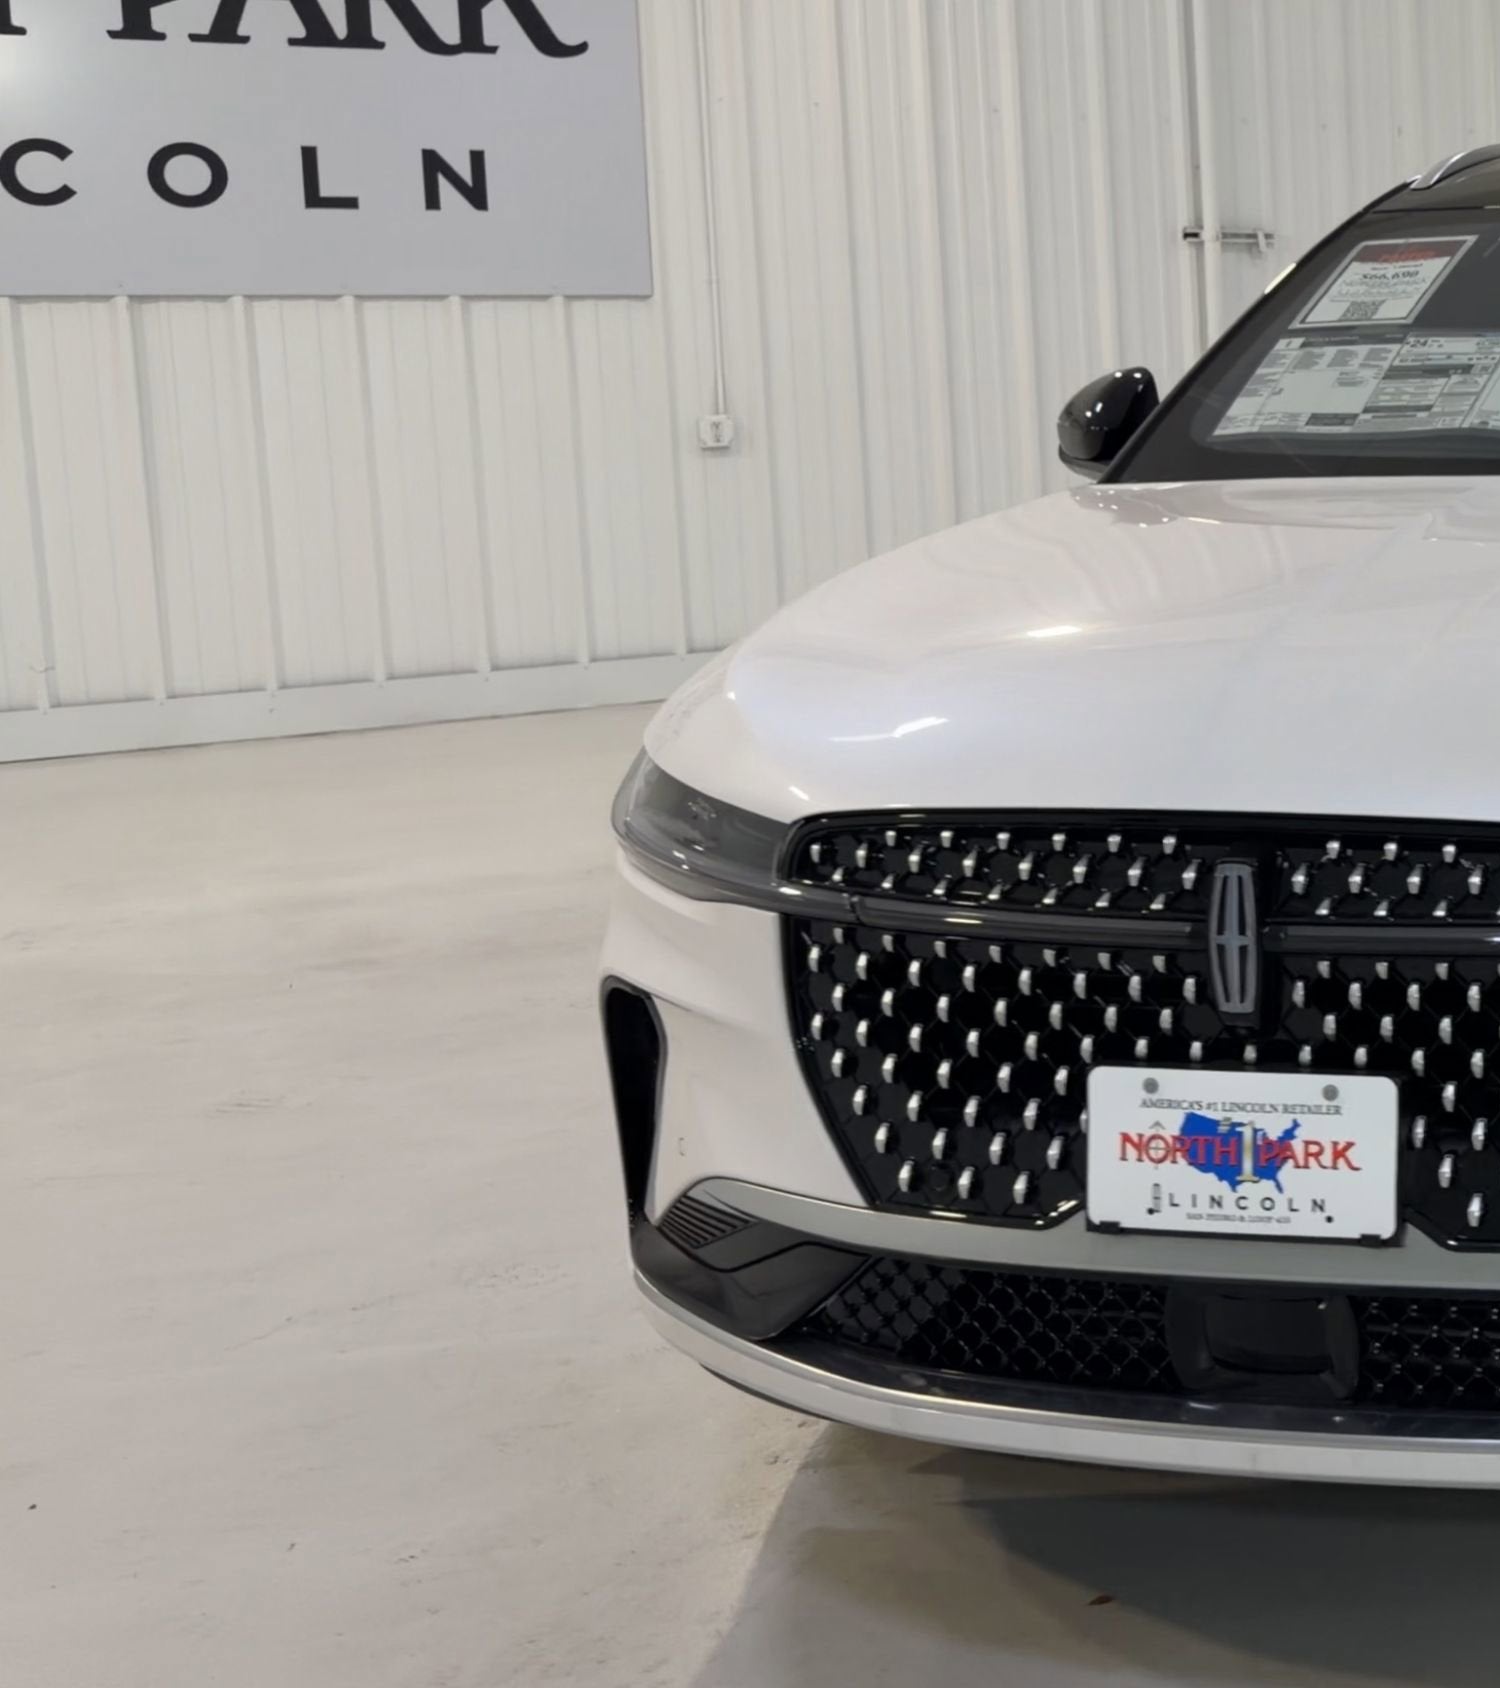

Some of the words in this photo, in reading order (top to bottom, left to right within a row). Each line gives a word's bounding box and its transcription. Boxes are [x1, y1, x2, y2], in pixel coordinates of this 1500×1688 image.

[1139, 1098, 1204, 1111] AMERICA'S
[1221, 1102, 1280, 1114] LINCOLN
[1281, 1103, 1342, 1115] RETAILER
[1119, 1132, 1238, 1165] NORTH
[1260, 1138, 1362, 1170] PARK
[1168, 1192, 1326, 1213] LINCOLN
